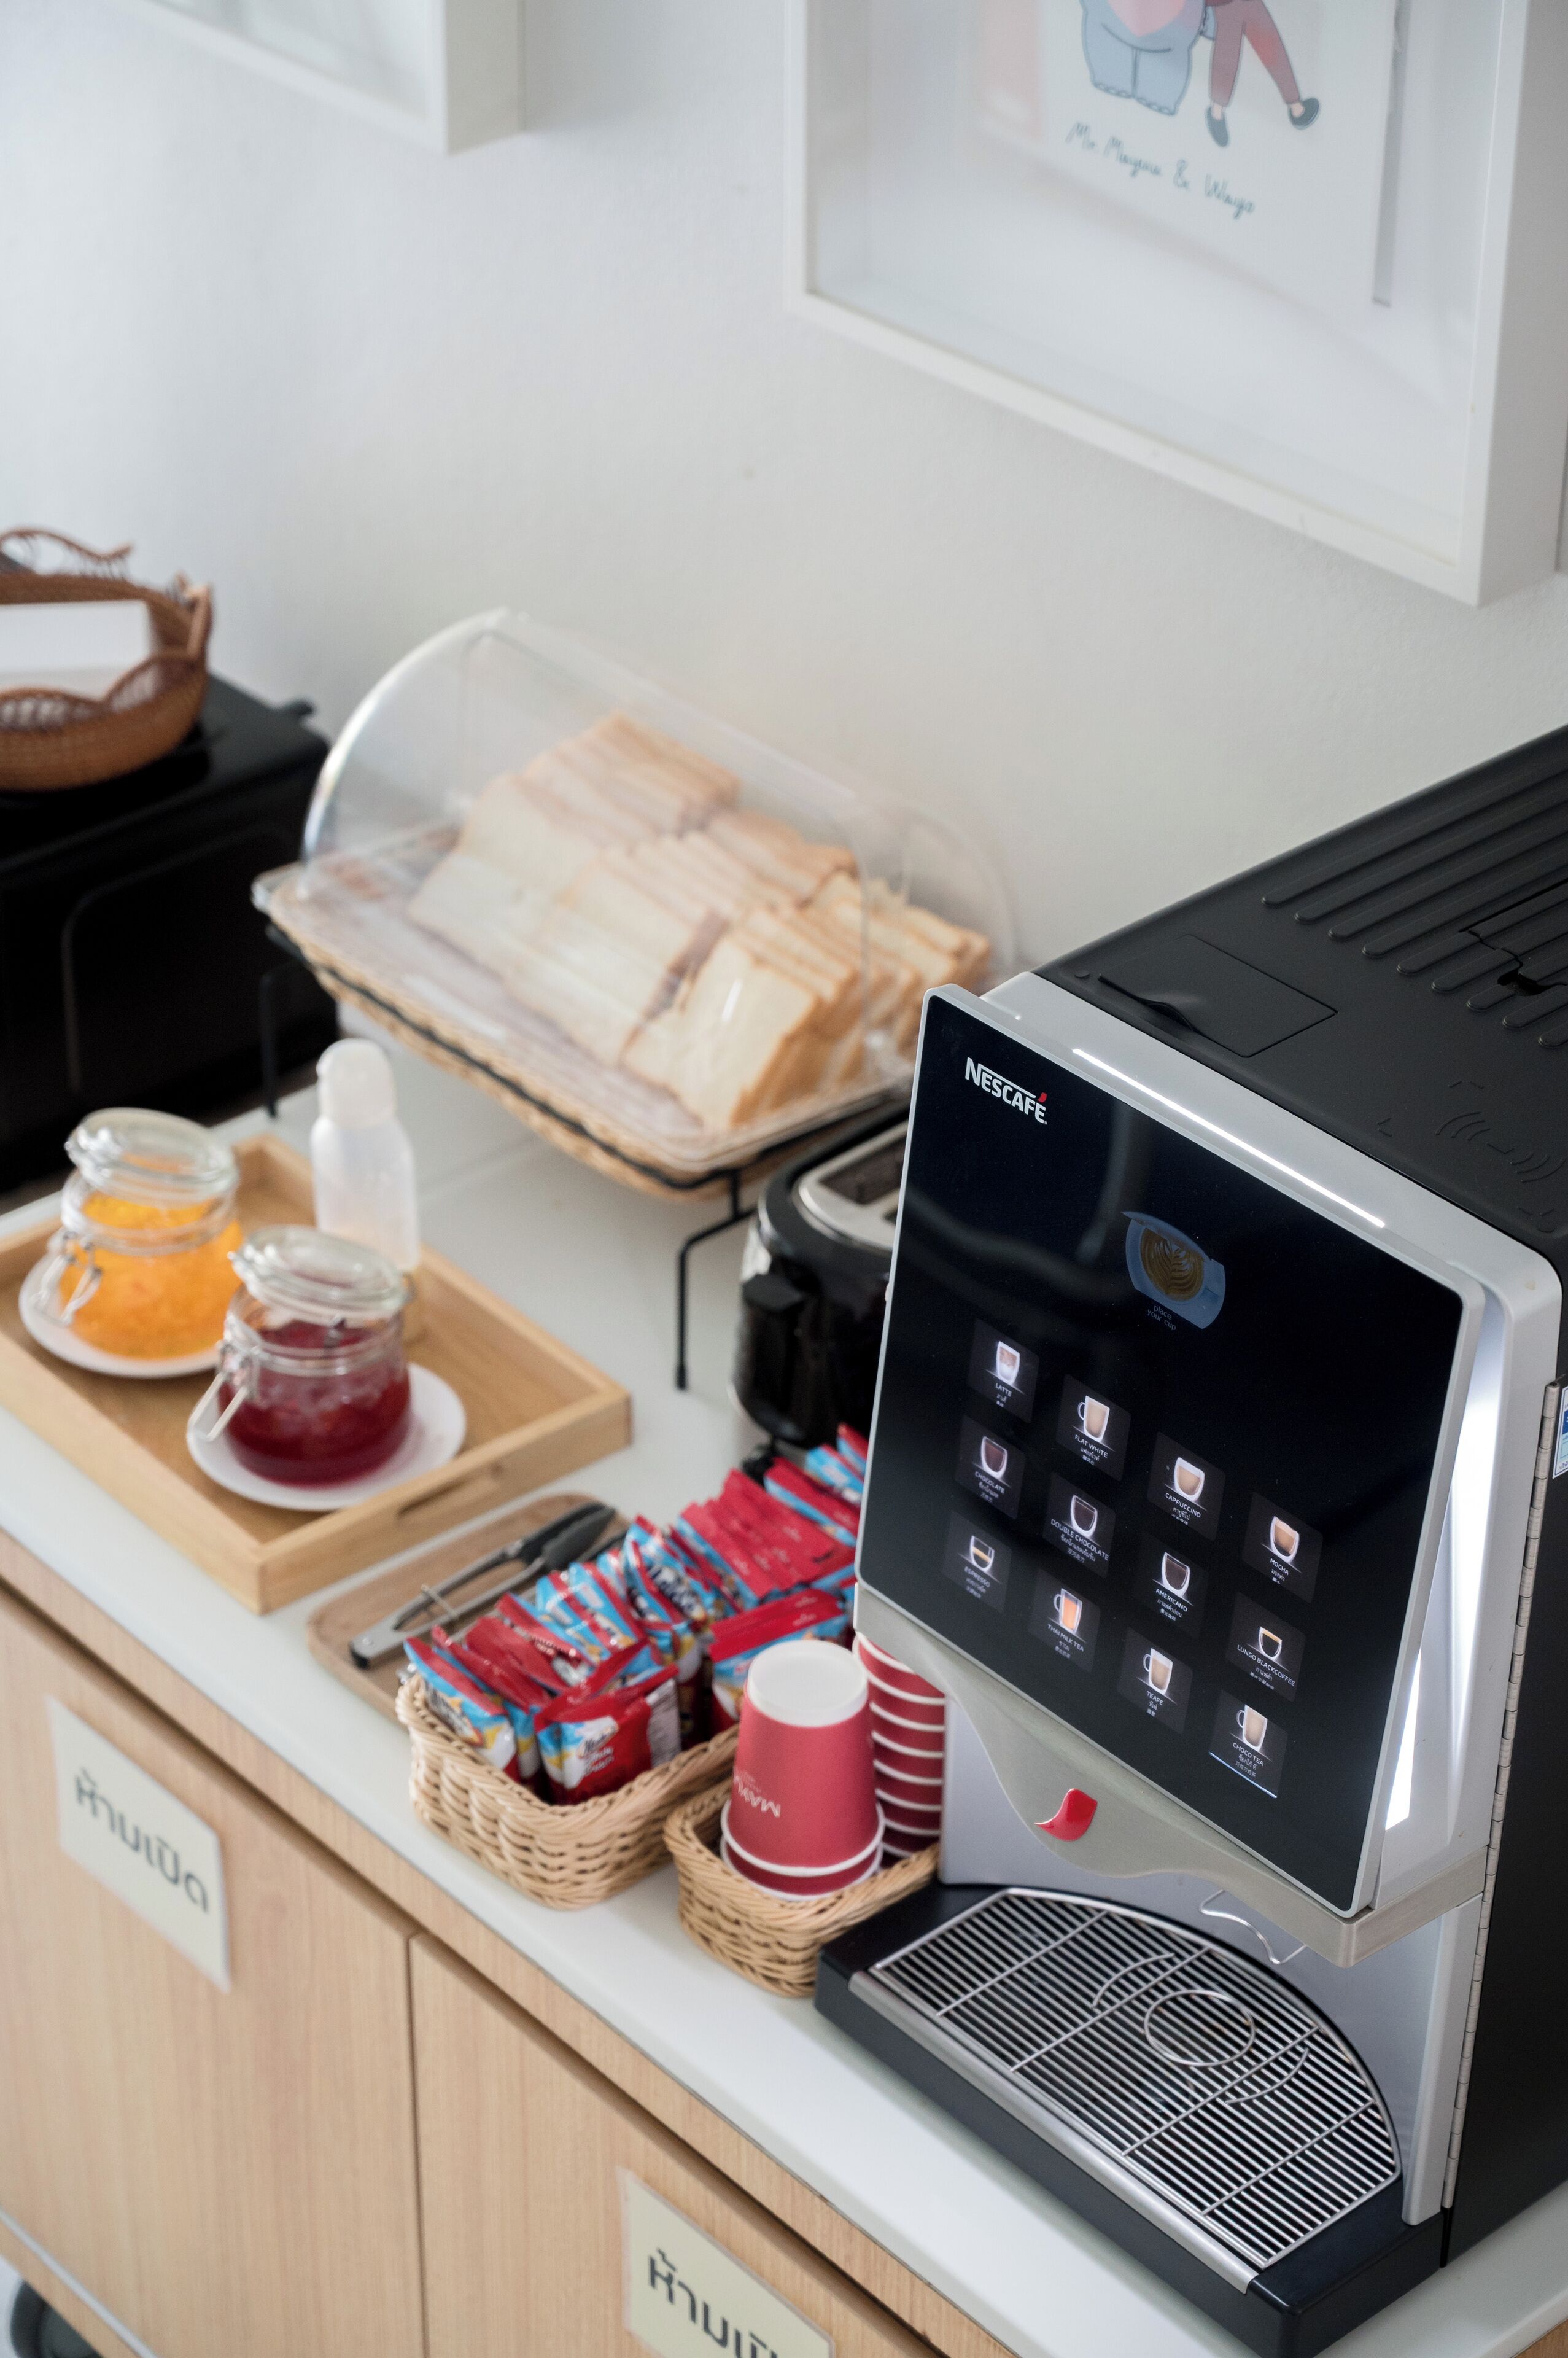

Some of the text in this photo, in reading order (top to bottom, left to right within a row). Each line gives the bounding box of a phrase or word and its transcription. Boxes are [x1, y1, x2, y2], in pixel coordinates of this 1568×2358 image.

[1173, 158, 1189, 188] &
[965, 1057, 1047, 1124] NESCAFÉ
[1147, 1309, 1177, 1330] your cup
[1154, 1305, 1172, 1320] place
[995, 1383, 1012, 1397] LATTE
[1074, 1434, 1108, 1458] FLAT WHITE
[975, 1471, 1005, 1493] CHOCOLATE
[1165, 1493, 1201, 1518] CAPPUCCINO
[1050, 1519, 1109, 1560] DOUBLE CHOCOLATE
[964, 1566, 990, 1587] ESPRESSO
[1270, 1558, 1289, 1576] MOCHA
[1155, 1589, 1187, 1612] AMERICANO
[1047, 1624, 1060, 1636] THAI
[1060, 1632, 1073, 1644] MILK
[1073, 1641, 1084, 1652] TEA
[1237, 1644, 1256, 1660] LUNGO
[1257, 1657, 1295, 1687] BLACKCOFFEE
[1146, 1691, 1163, 1706] TEAFE
[1233, 1742, 1263, 1767] CHOCO TEA
[75, 1767, 209, 1914] ห้ามเปิด
